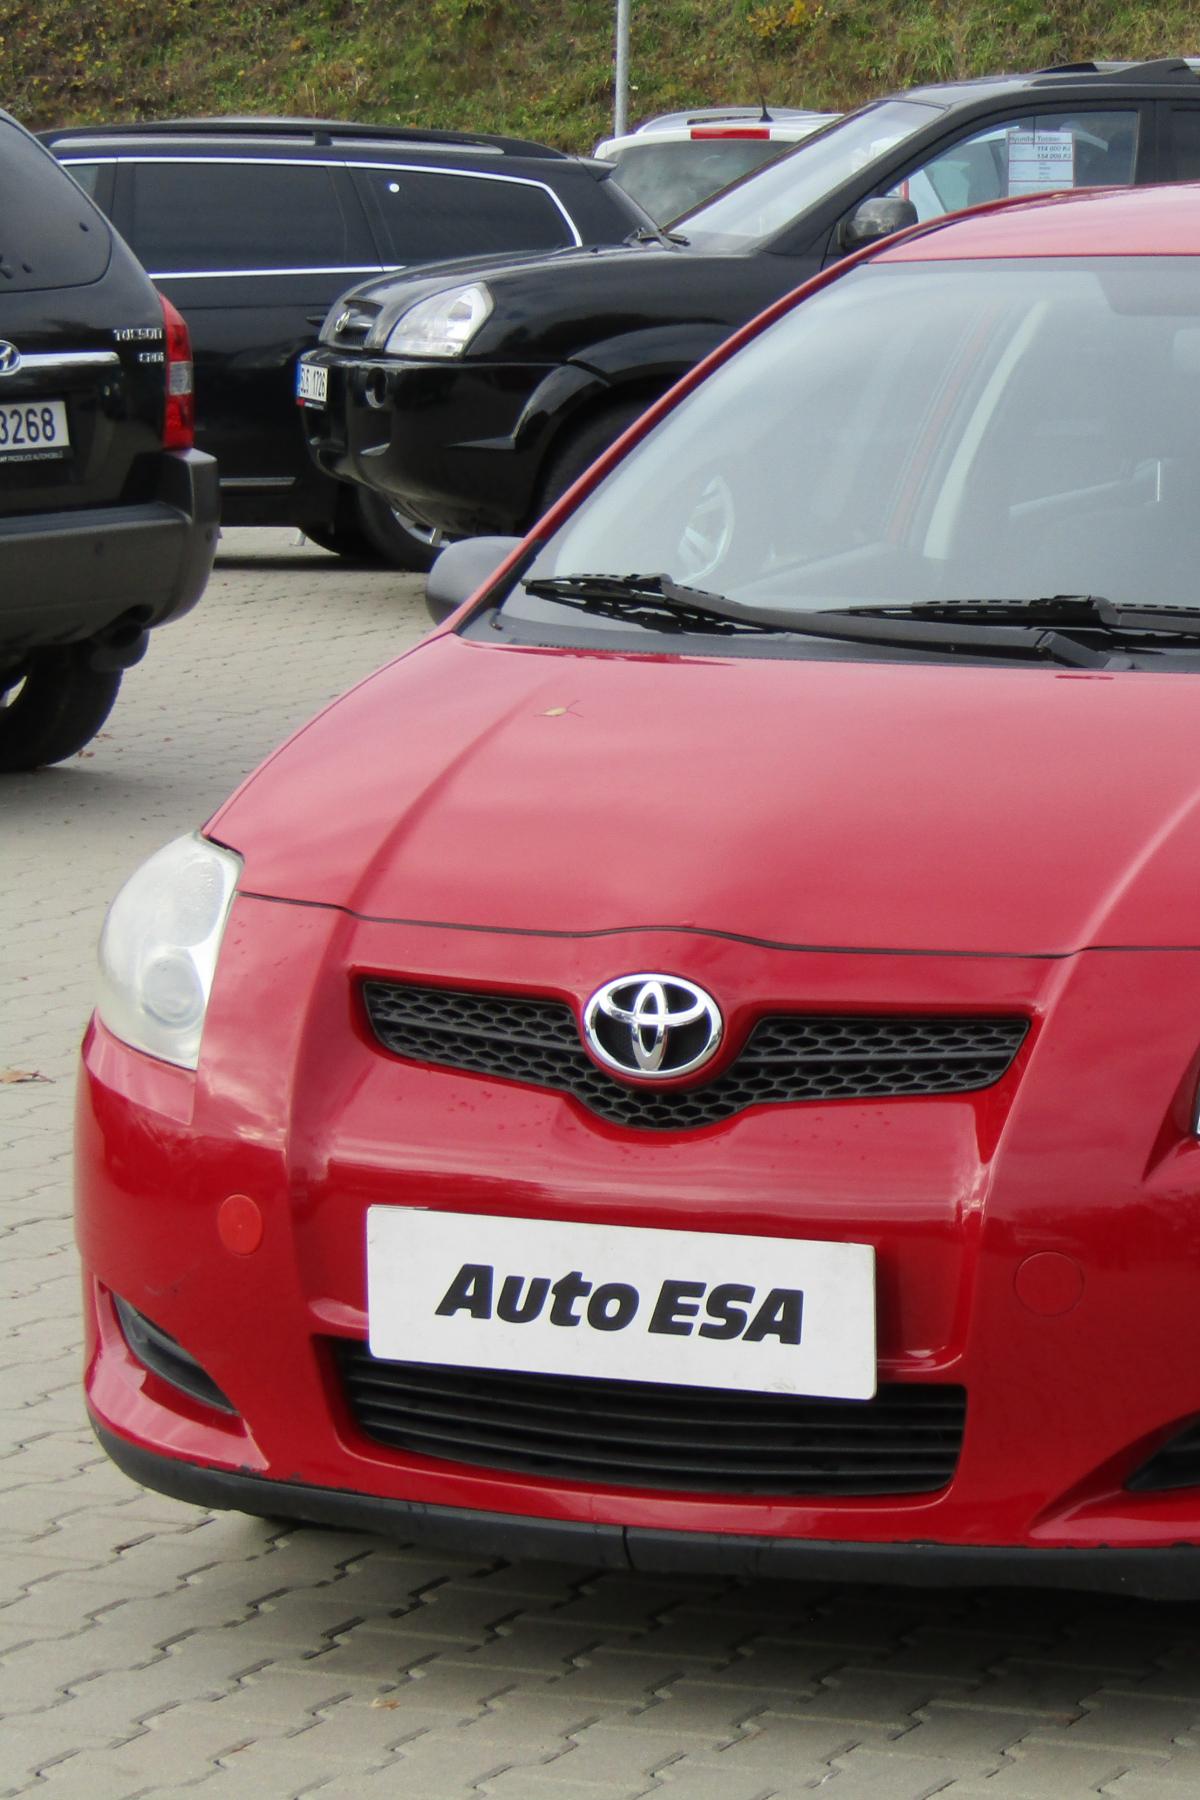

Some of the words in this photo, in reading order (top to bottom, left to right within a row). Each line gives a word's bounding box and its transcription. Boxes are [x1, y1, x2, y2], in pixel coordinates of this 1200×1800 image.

[0, 408, 55, 444] 3268
[435, 1263, 640, 1332] Auto
[647, 1279, 804, 1346] ESA
